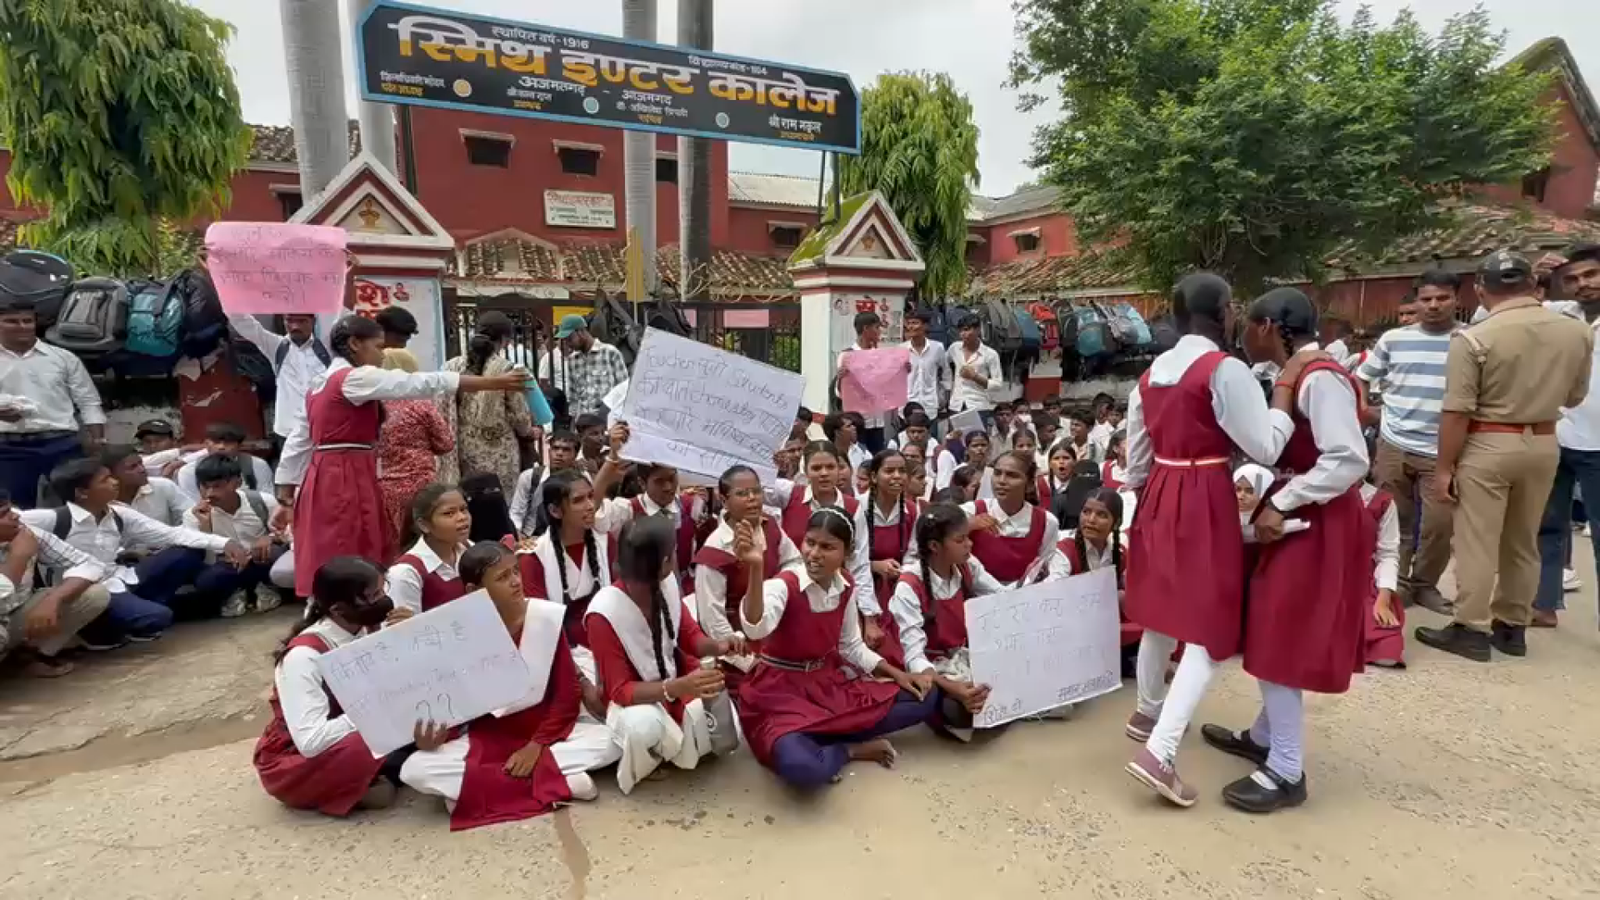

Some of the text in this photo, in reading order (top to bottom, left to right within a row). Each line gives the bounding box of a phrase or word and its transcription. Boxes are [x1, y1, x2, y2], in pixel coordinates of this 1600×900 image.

[387, 15, 841, 115] स्मिथ इण्टर कालेज
